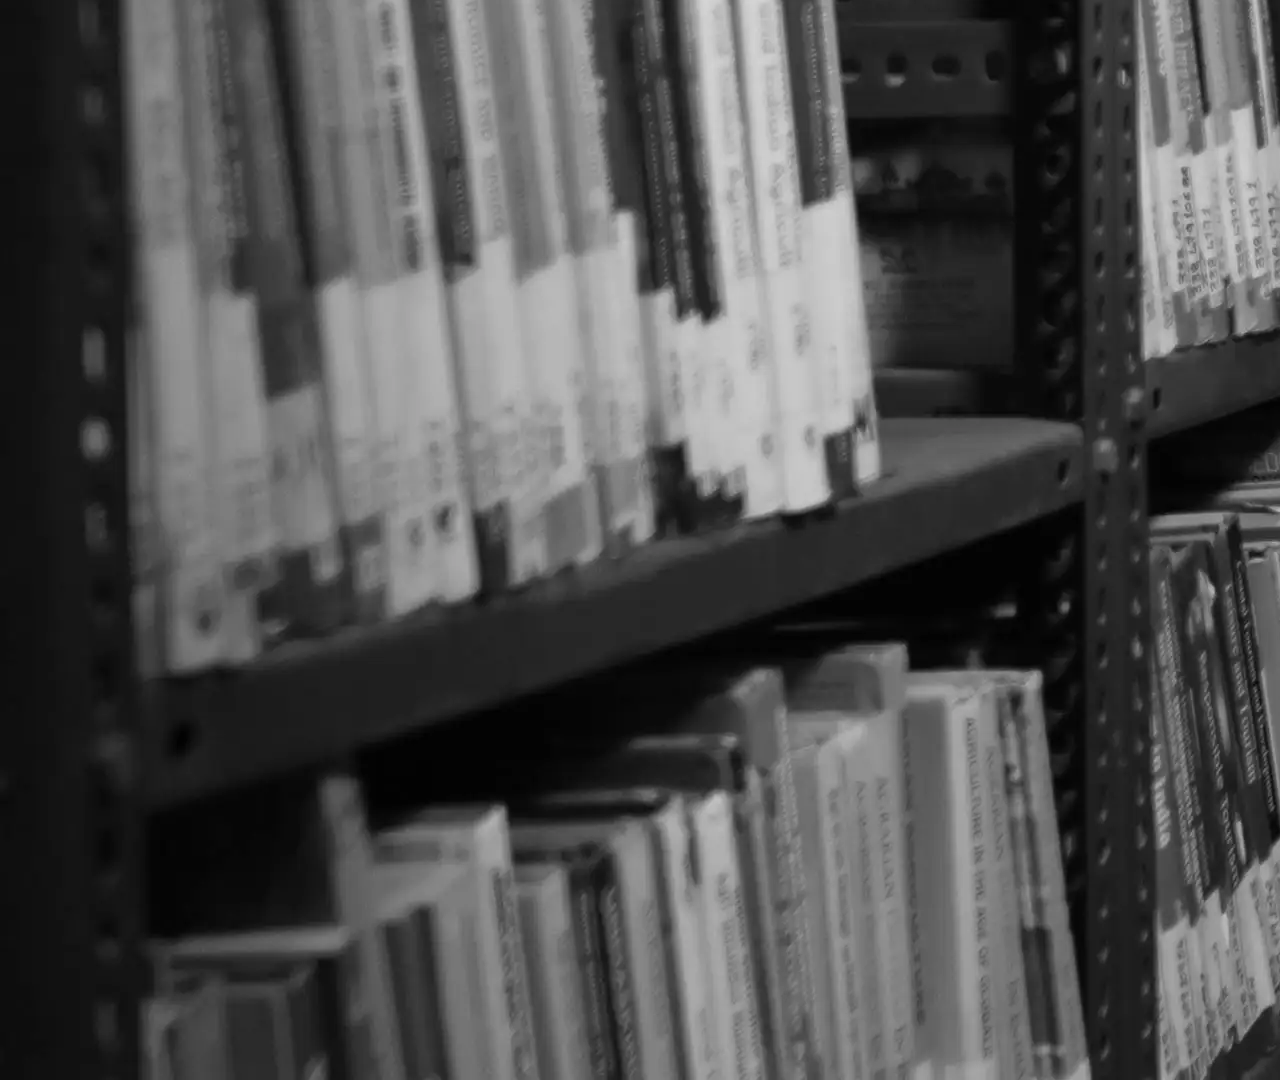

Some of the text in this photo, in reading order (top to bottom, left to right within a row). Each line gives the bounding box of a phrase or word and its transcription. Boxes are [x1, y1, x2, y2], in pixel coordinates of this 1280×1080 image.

[1232, 661, 1250, 700] and
[1198, 649, 1225, 792] Responsible
[1239, 703, 1260, 785] Tourism
[965, 717, 984, 842] AGRICULTURE
[971, 845, 986, 864] IN
[974, 871, 988, 901] THE
[976, 906, 990, 943] AGE
[978, 946, 991, 968] OF
